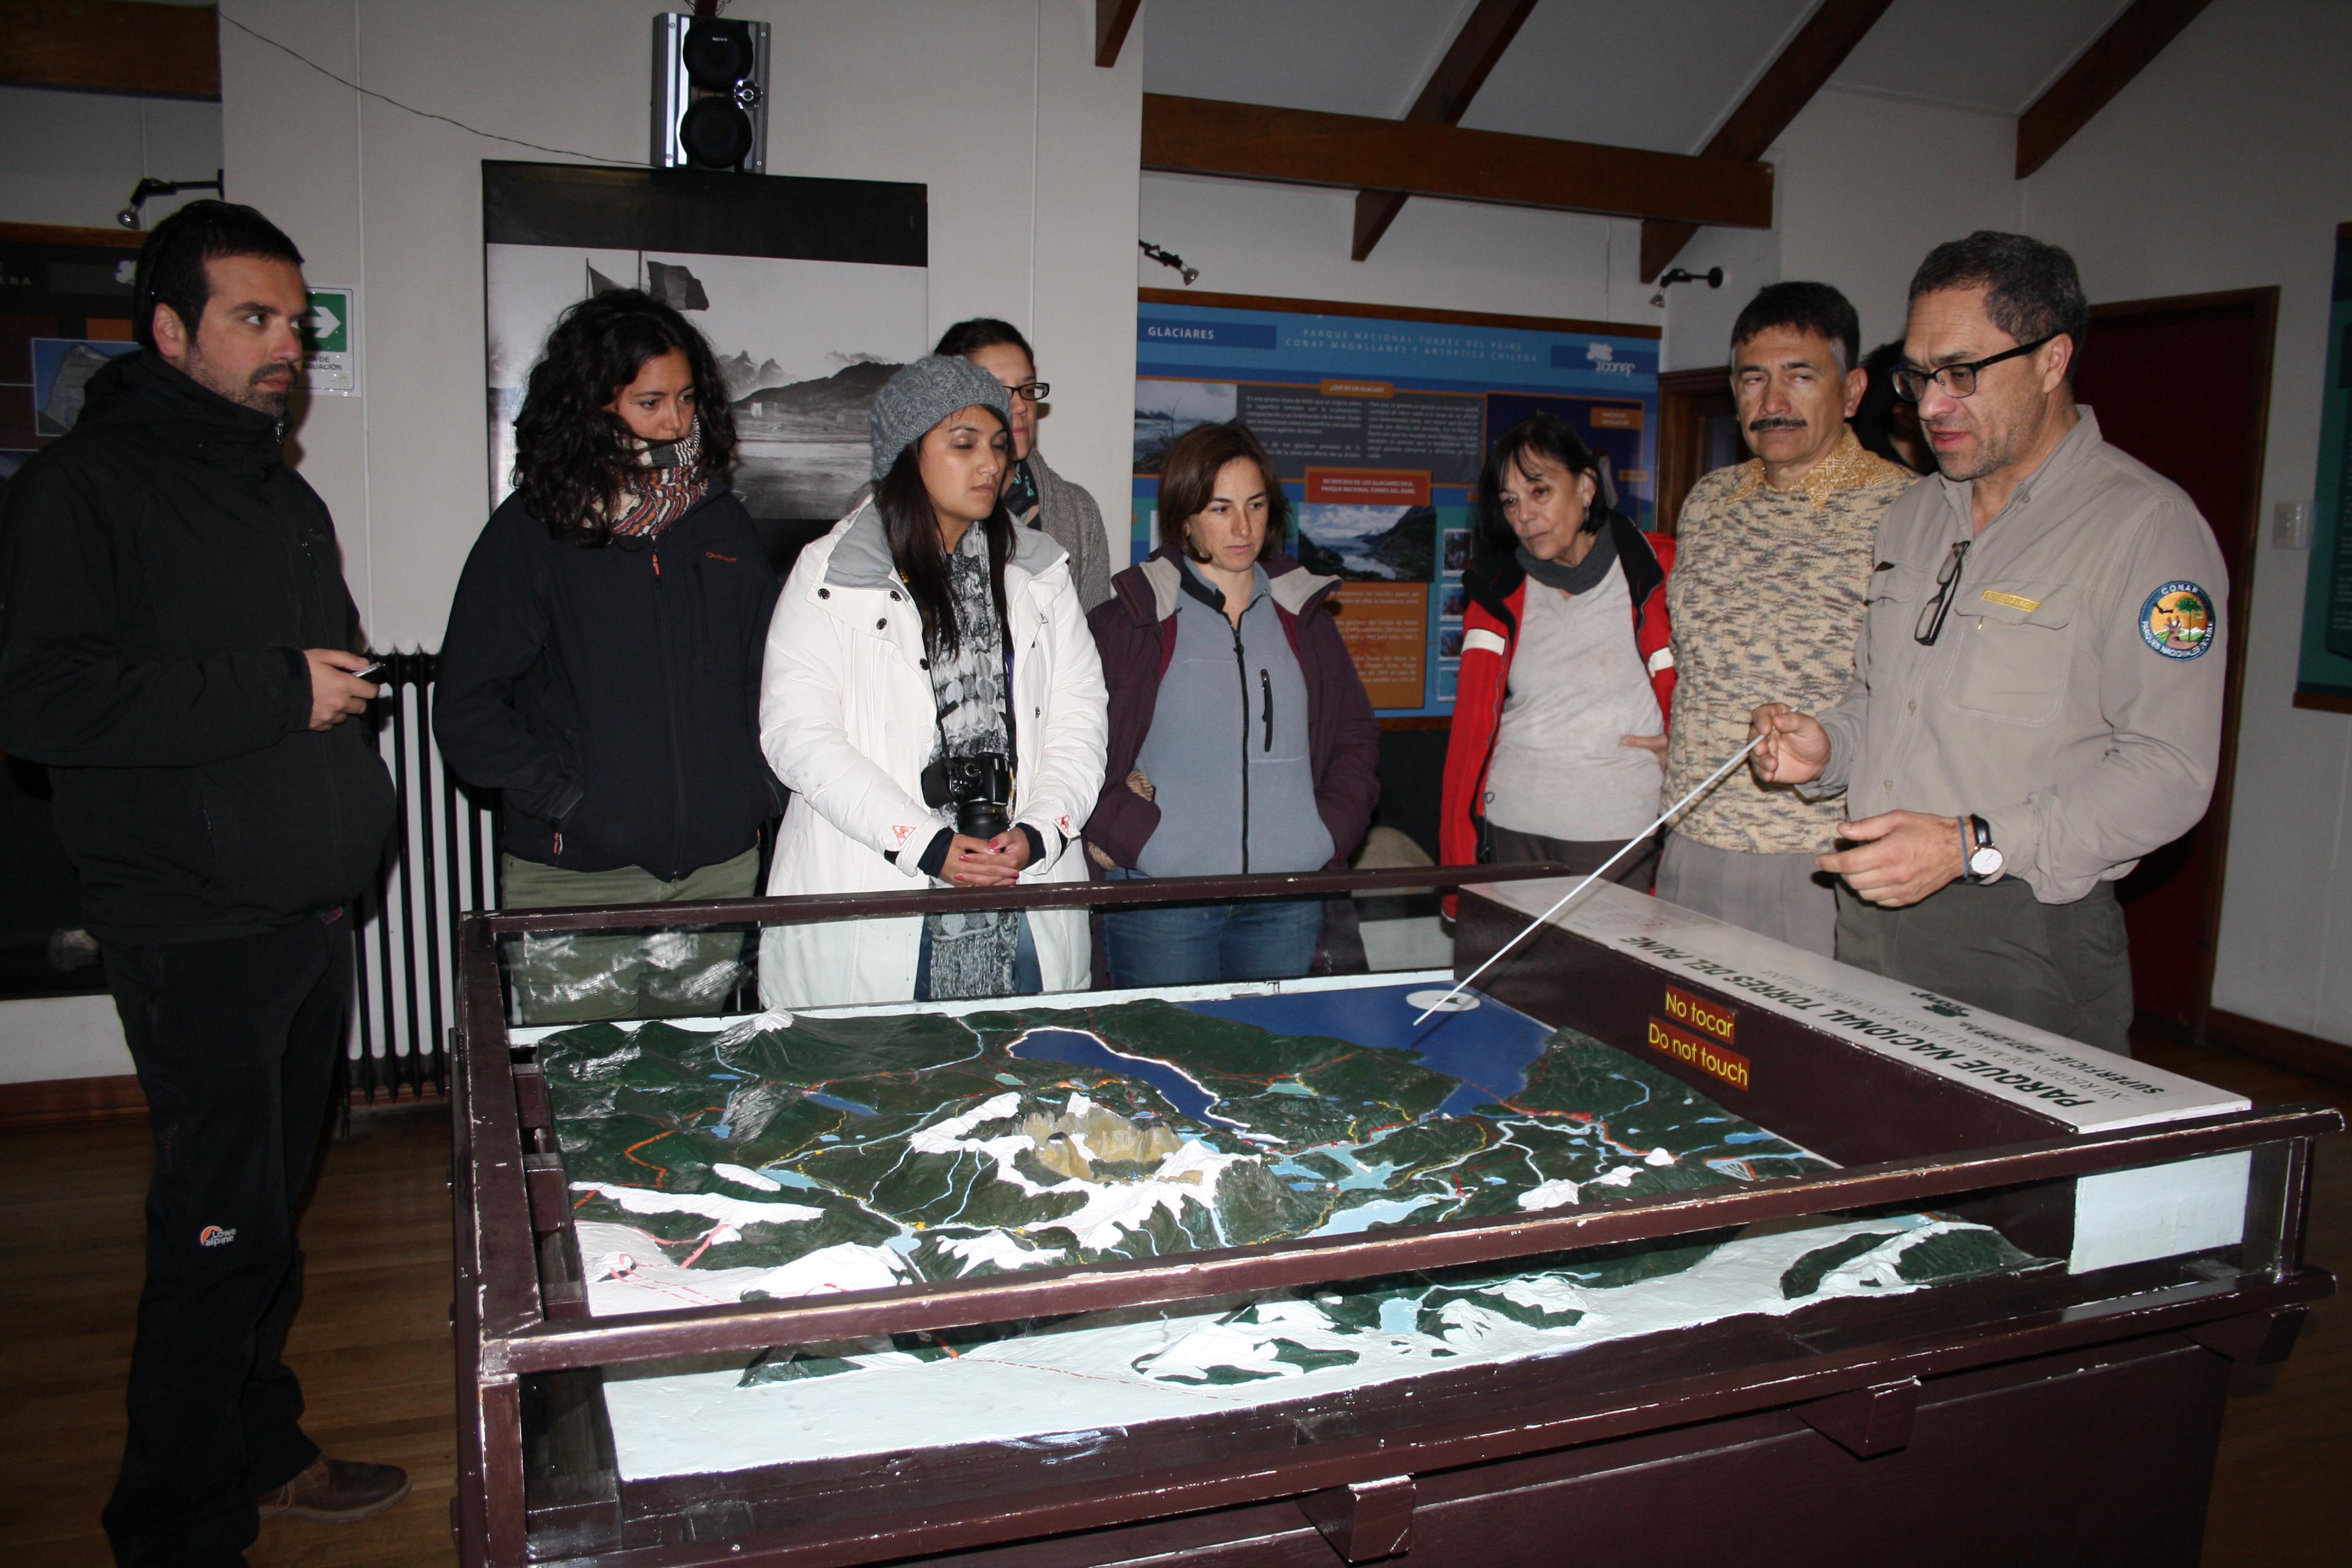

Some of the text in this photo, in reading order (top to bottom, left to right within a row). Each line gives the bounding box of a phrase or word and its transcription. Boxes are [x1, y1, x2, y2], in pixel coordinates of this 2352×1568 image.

[1147, 325, 1215, 340] GLACIARES
[1302, 328, 1522, 351] PARQUE NACIONAL TORRES DEL PAINE
[1285, 338, 1324, 348] CONAF
[1330, 341, 1407, 353] MAGALLANES
[1491, 350, 1538, 362] CHILENA
[2161, 584, 2198, 595] CONAF
[2141, 621, 2160, 650] PARQUES
[1619, 936, 2097, 1108] PARQUE NACIONAL TORRES DEL PAINE
[1665, 991, 1734, 1038] No tocar
[1648, 1022, 1748, 1086] Do not touch
[2051, 1056, 2165, 1095] SUPERFICIE
[205, 1235, 235, 1247] alpine
[212, 1228, 237, 1238] Lowe
